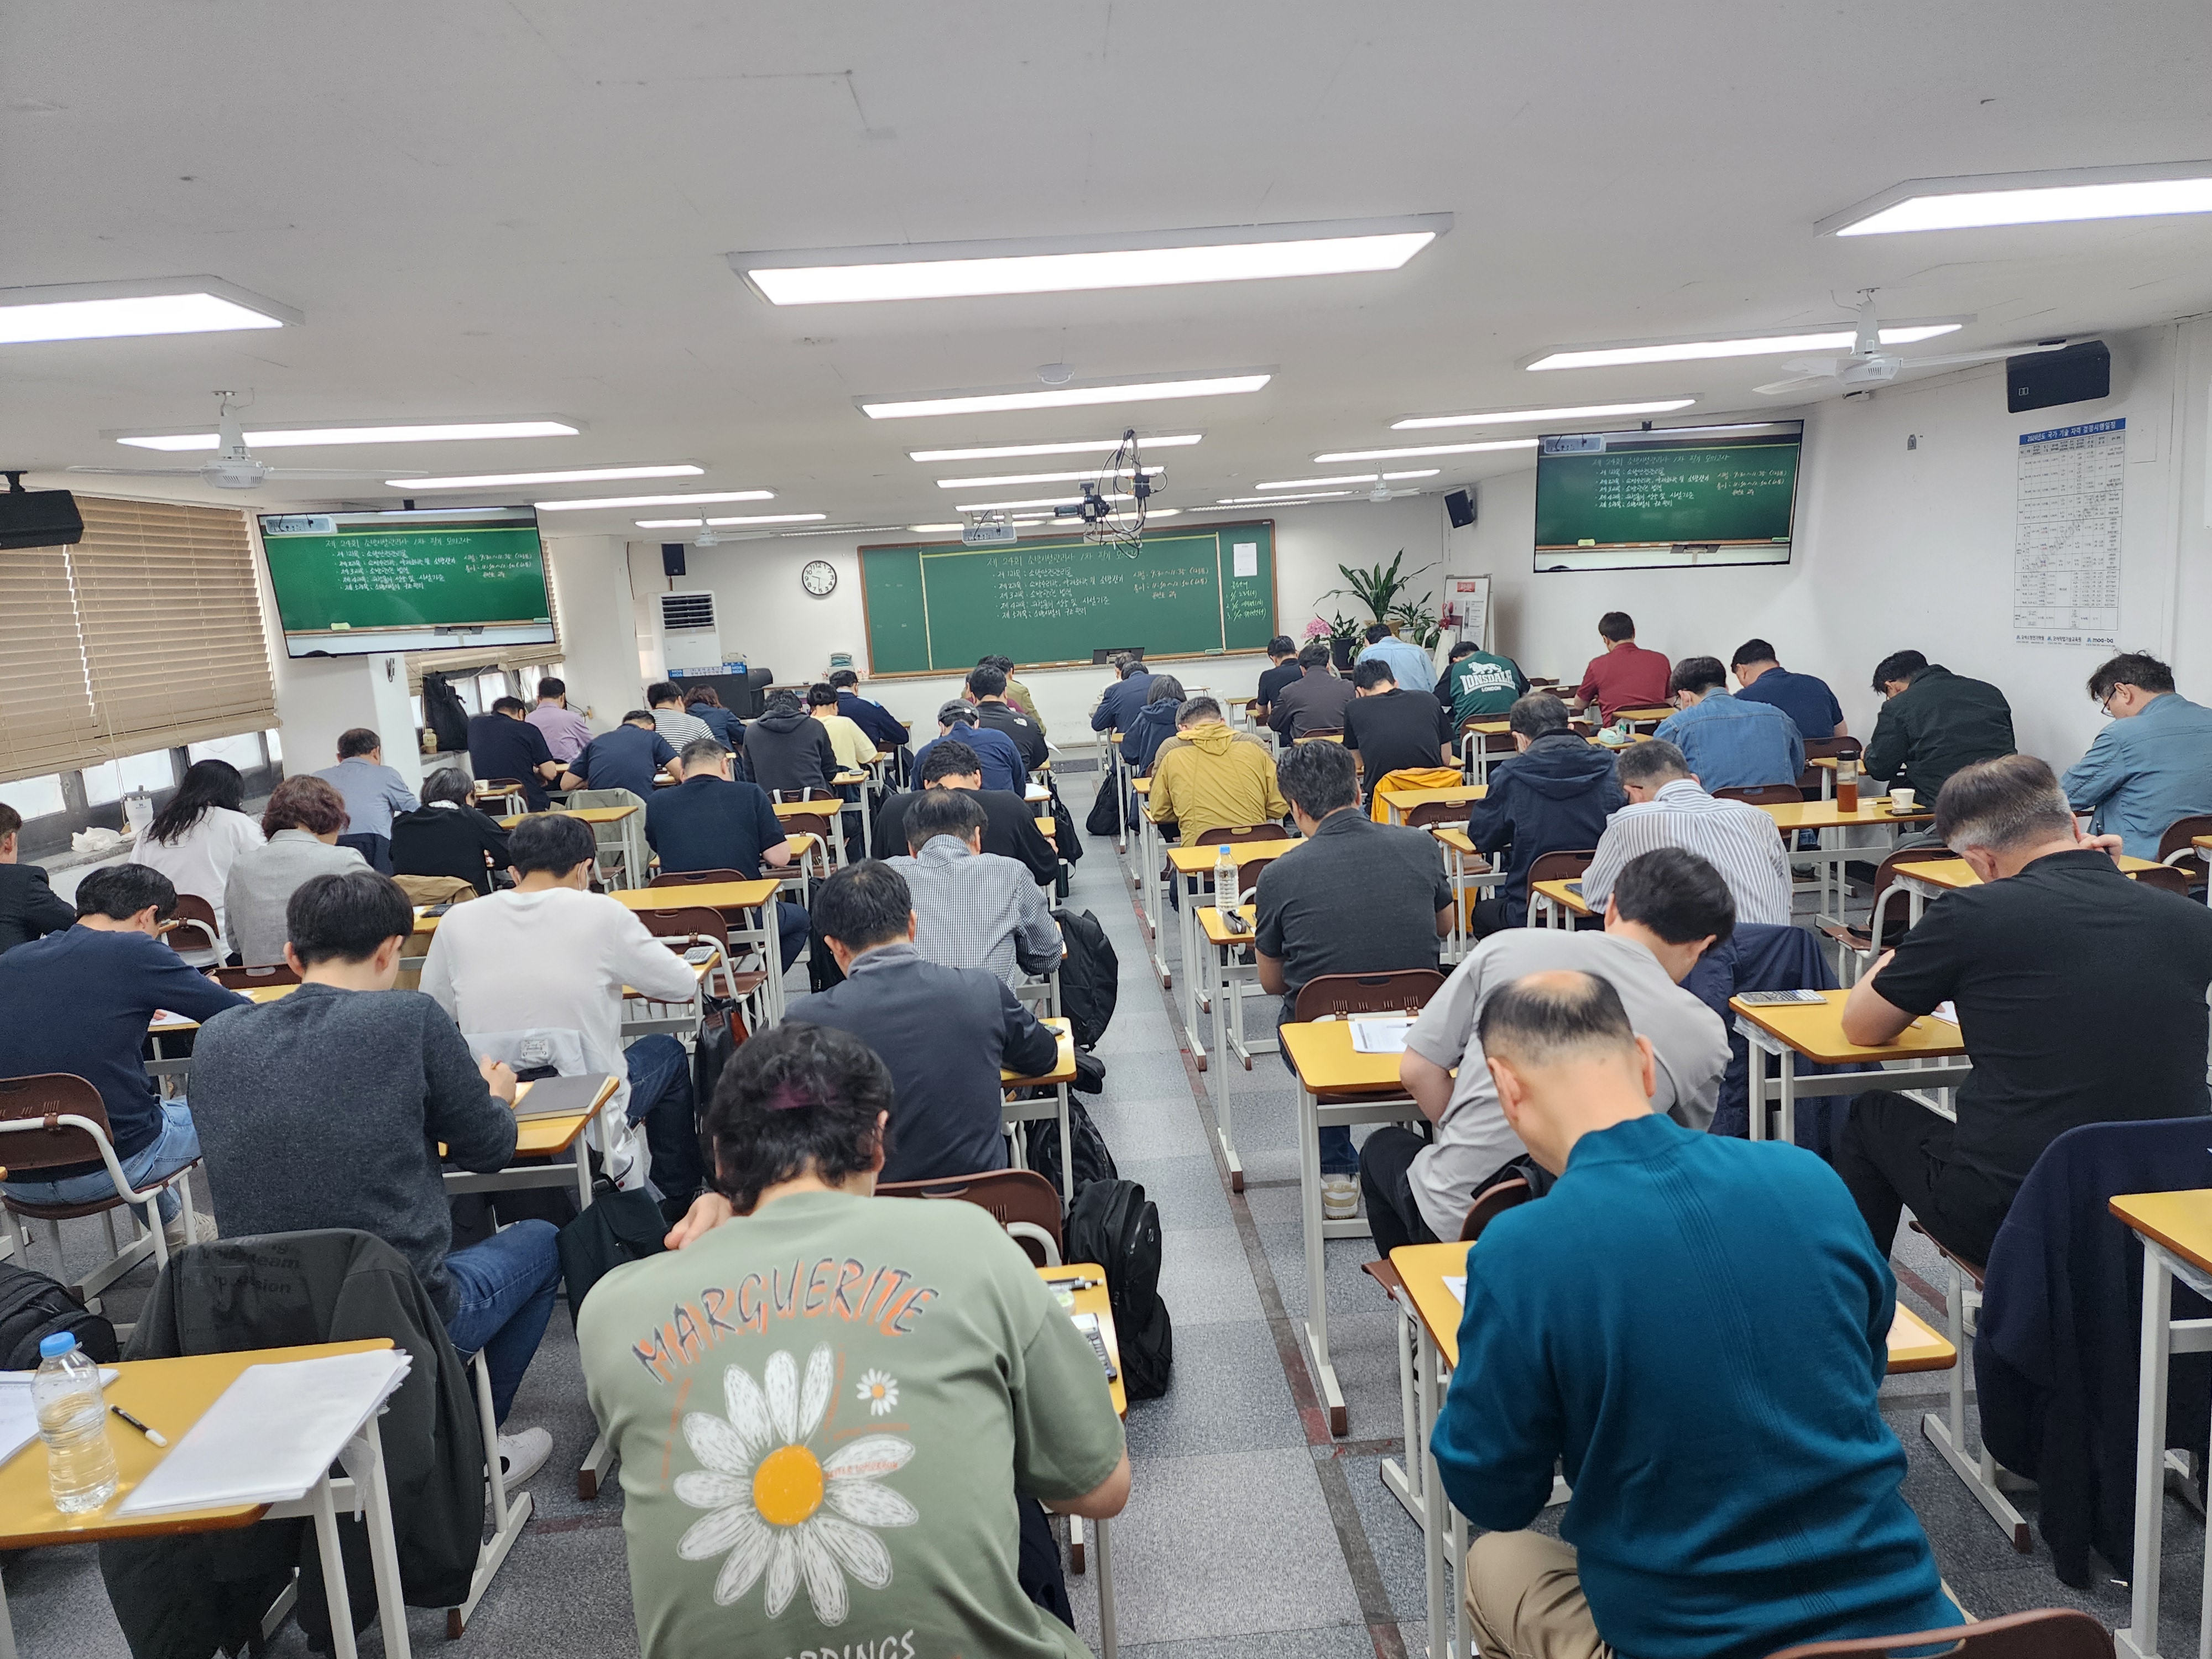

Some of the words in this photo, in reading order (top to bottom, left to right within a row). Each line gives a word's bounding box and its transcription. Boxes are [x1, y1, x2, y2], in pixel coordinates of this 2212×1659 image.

[1002, 555, 1022, 566] 24회
[1459, 669, 1516, 695] LONSDALE
[632, 1257, 940, 1384] MARGUERITE
